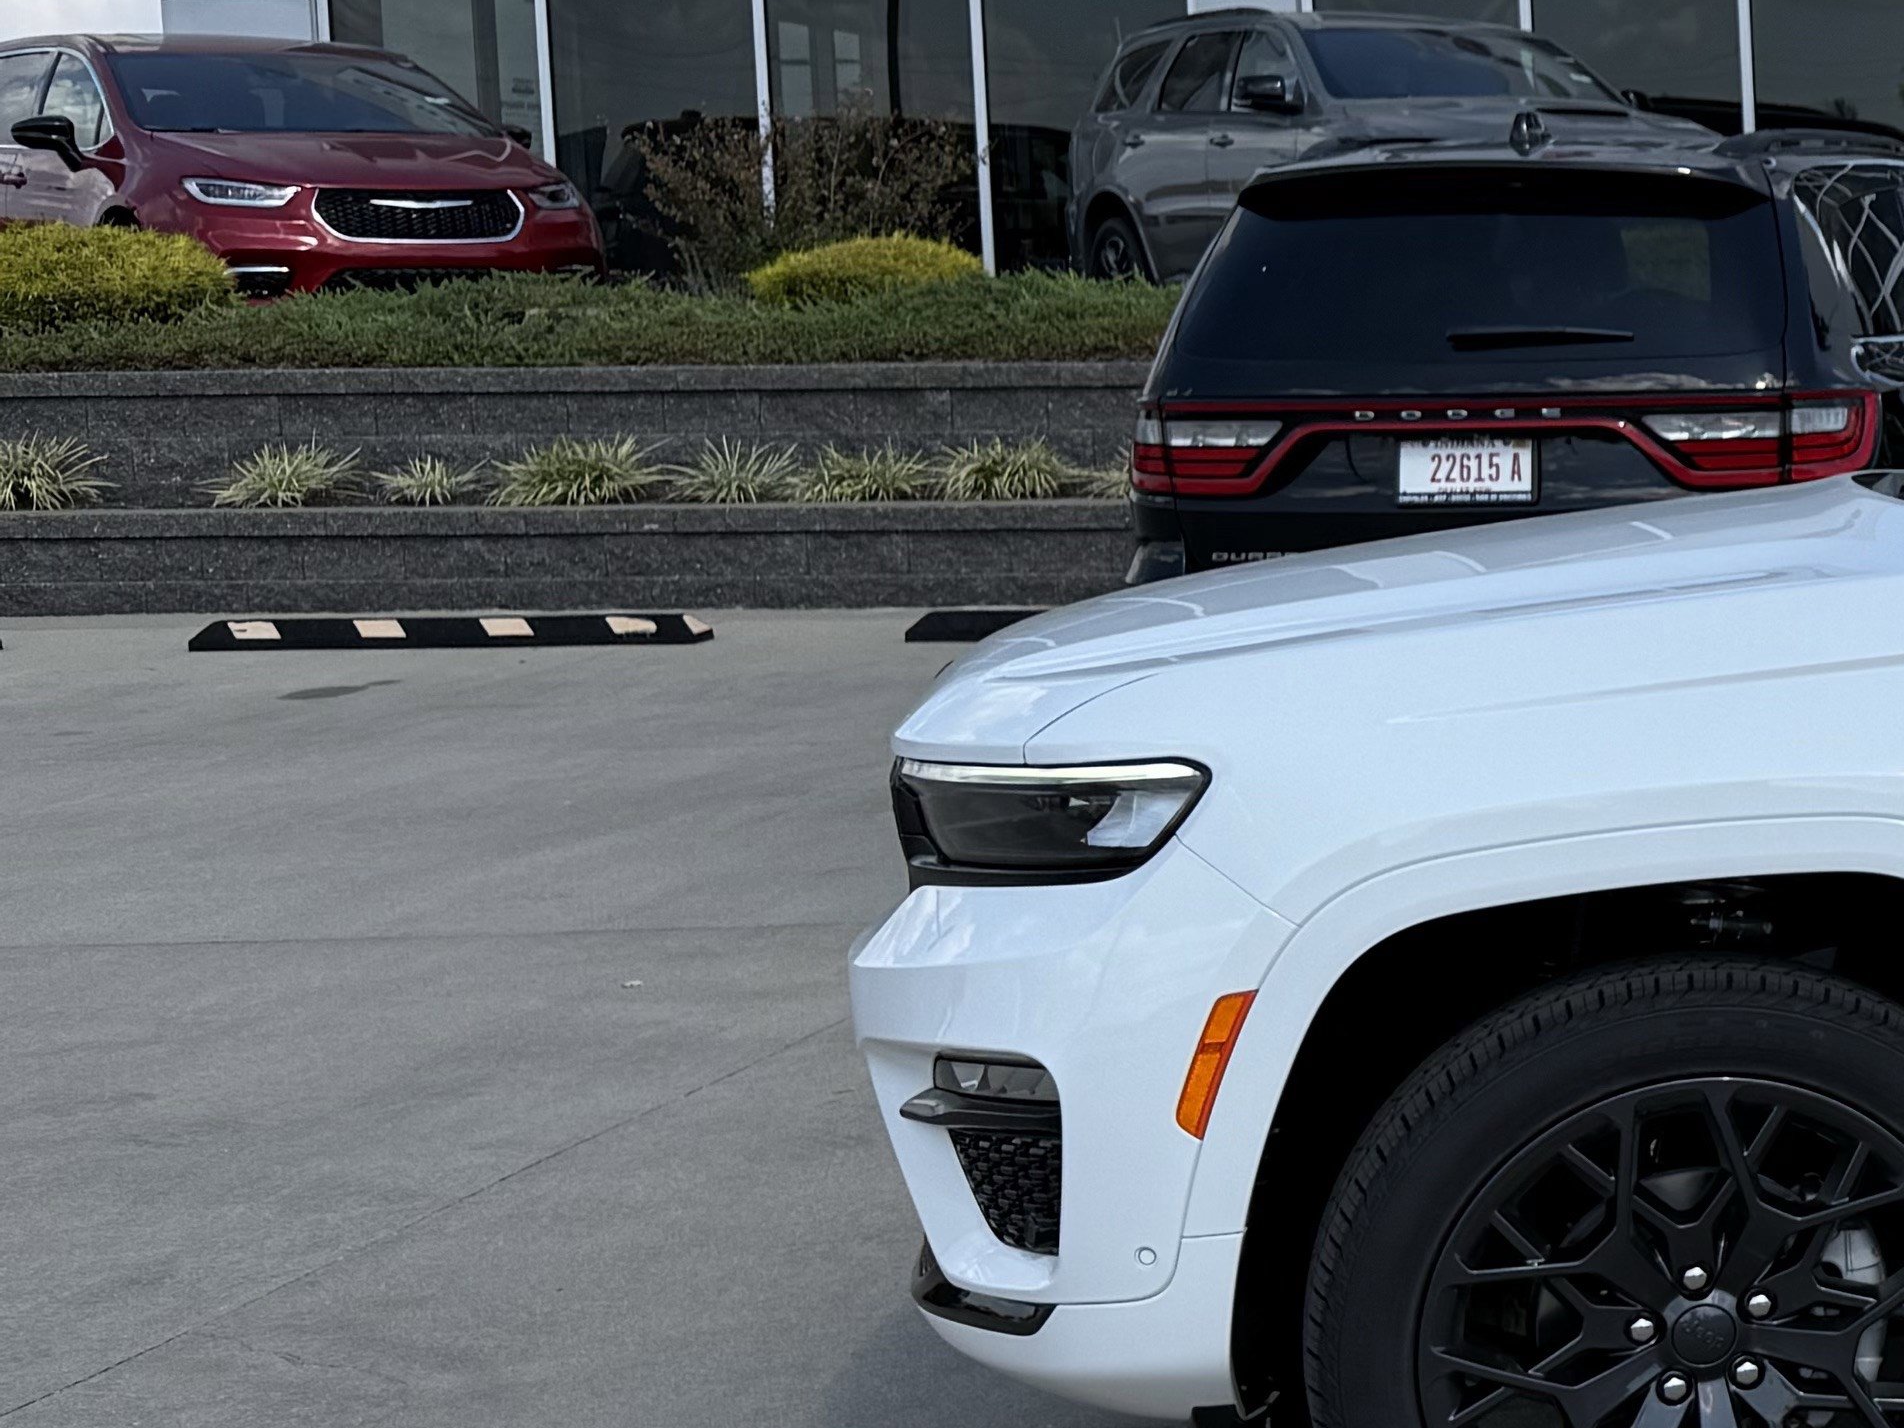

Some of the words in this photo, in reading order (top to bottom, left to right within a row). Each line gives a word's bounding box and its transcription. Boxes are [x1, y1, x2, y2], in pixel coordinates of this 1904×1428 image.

[1354, 406, 1562, 421] DODGE
[1430, 452, 1500, 483] 22615
[1510, 452, 1522, 482] A
